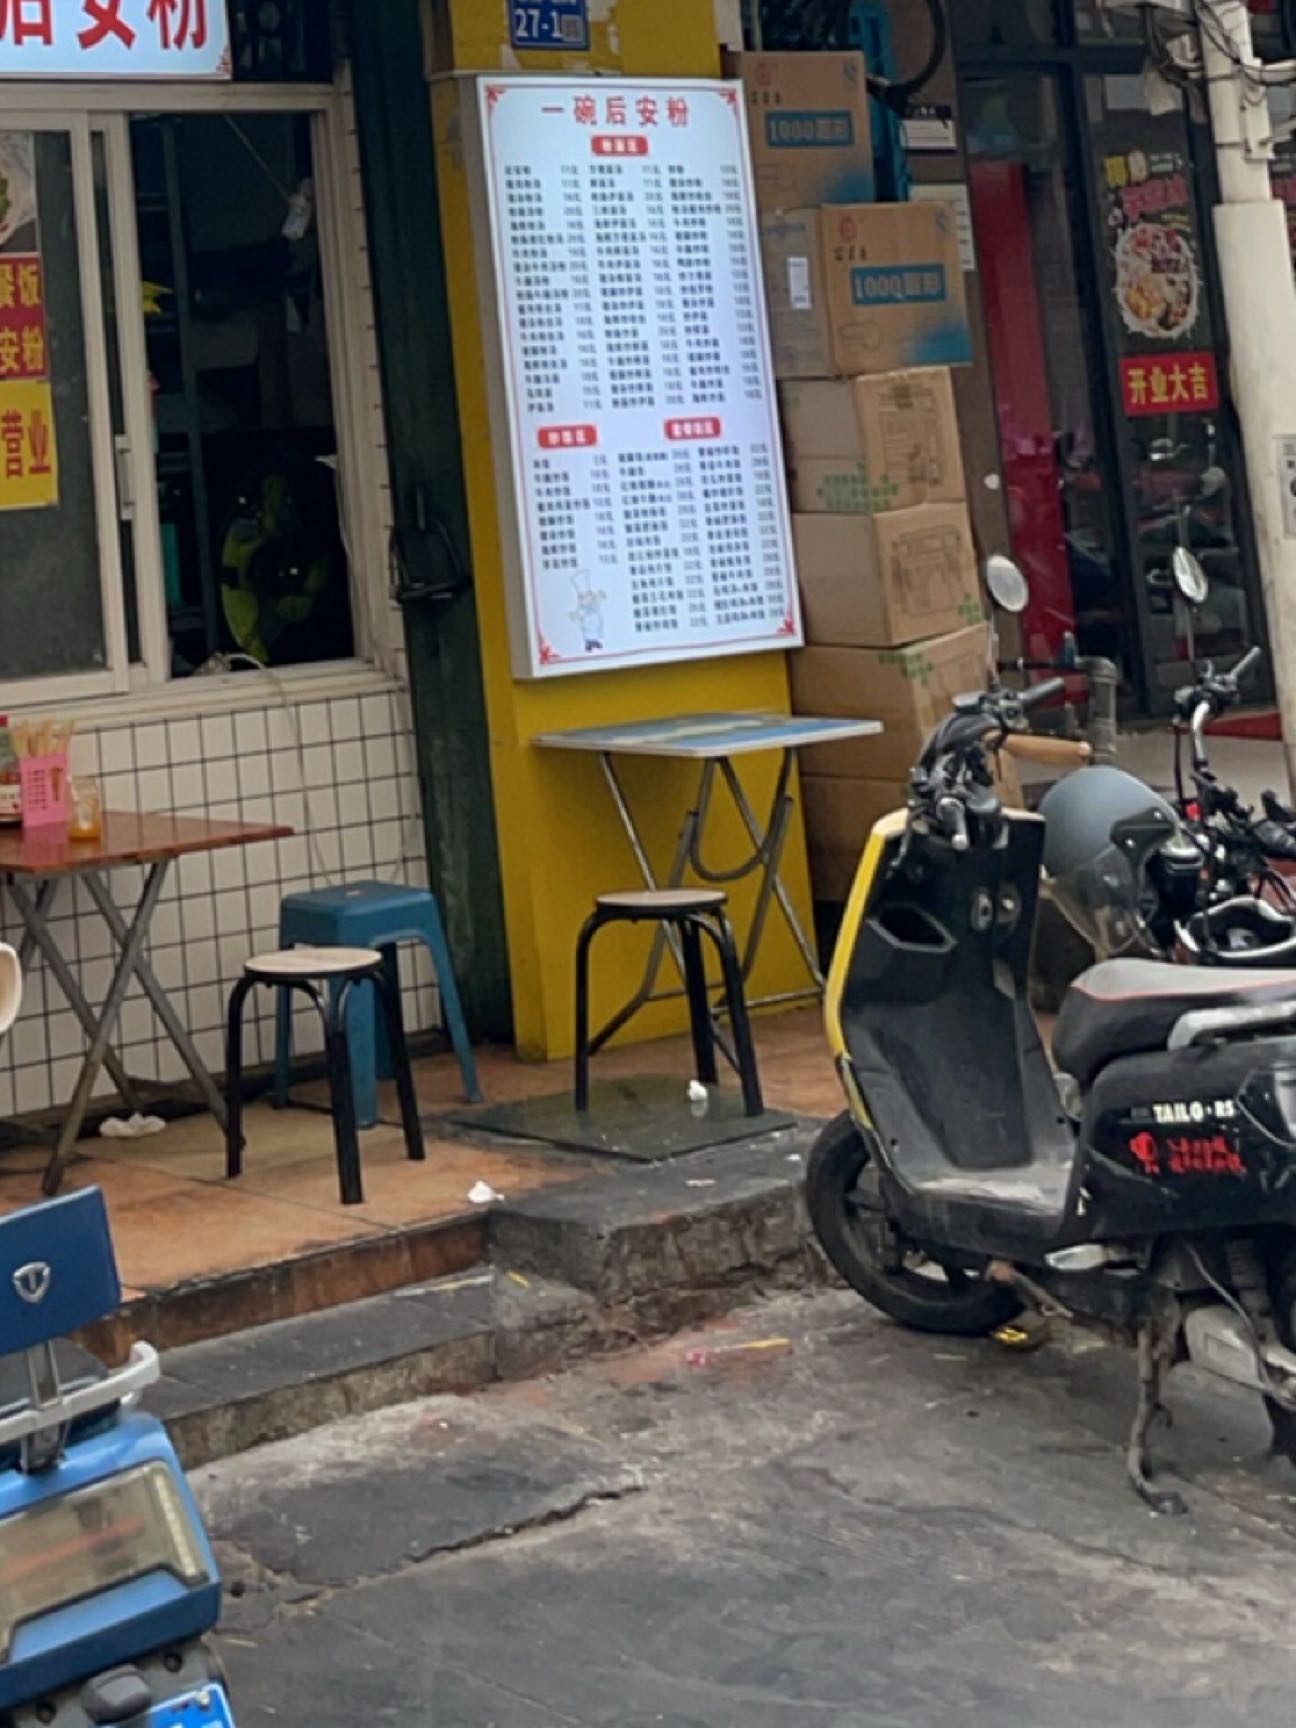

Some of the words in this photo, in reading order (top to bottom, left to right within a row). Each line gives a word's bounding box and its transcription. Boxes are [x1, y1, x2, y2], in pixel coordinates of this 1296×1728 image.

[540, 94, 692, 129] 一碗后安粉
[1127, 361, 1209, 406] 开业大吉
